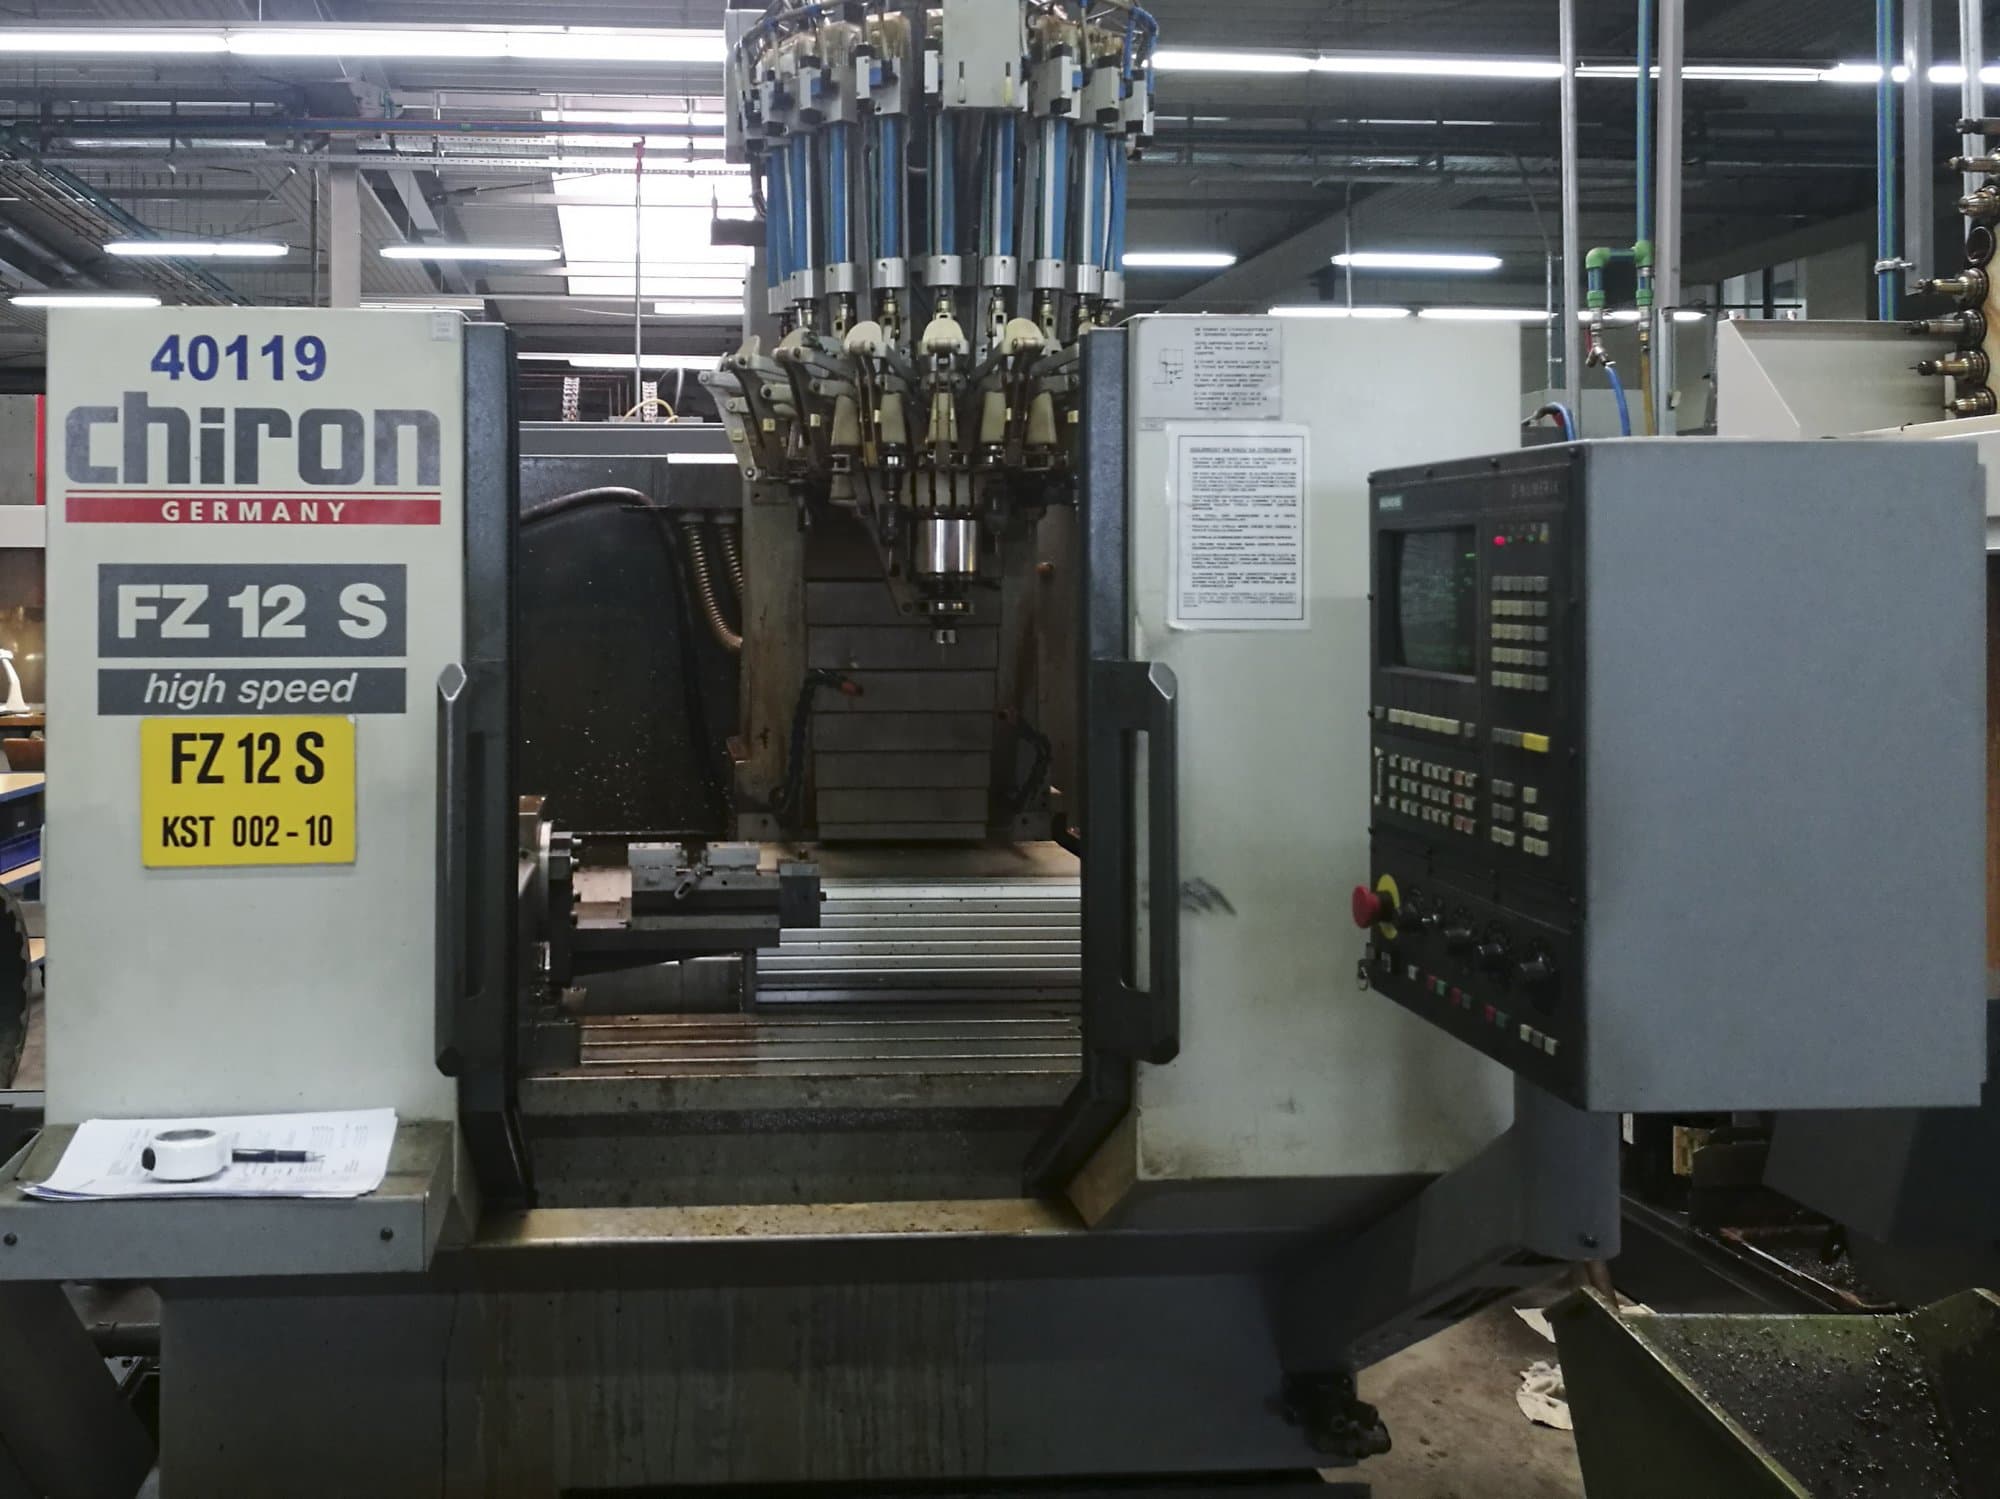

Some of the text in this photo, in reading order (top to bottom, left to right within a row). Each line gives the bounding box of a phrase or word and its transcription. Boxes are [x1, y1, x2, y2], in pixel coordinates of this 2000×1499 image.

[150, 334, 327, 382] 40119
[65, 391, 441, 487] chiron
[161, 500, 346, 522] GERMANY
[117, 582, 388, 640] FZ 12 S
[144, 672, 359, 711] high speed
[171, 730, 325, 785] FZ 12 S
[162, 815, 215, 848] KST
